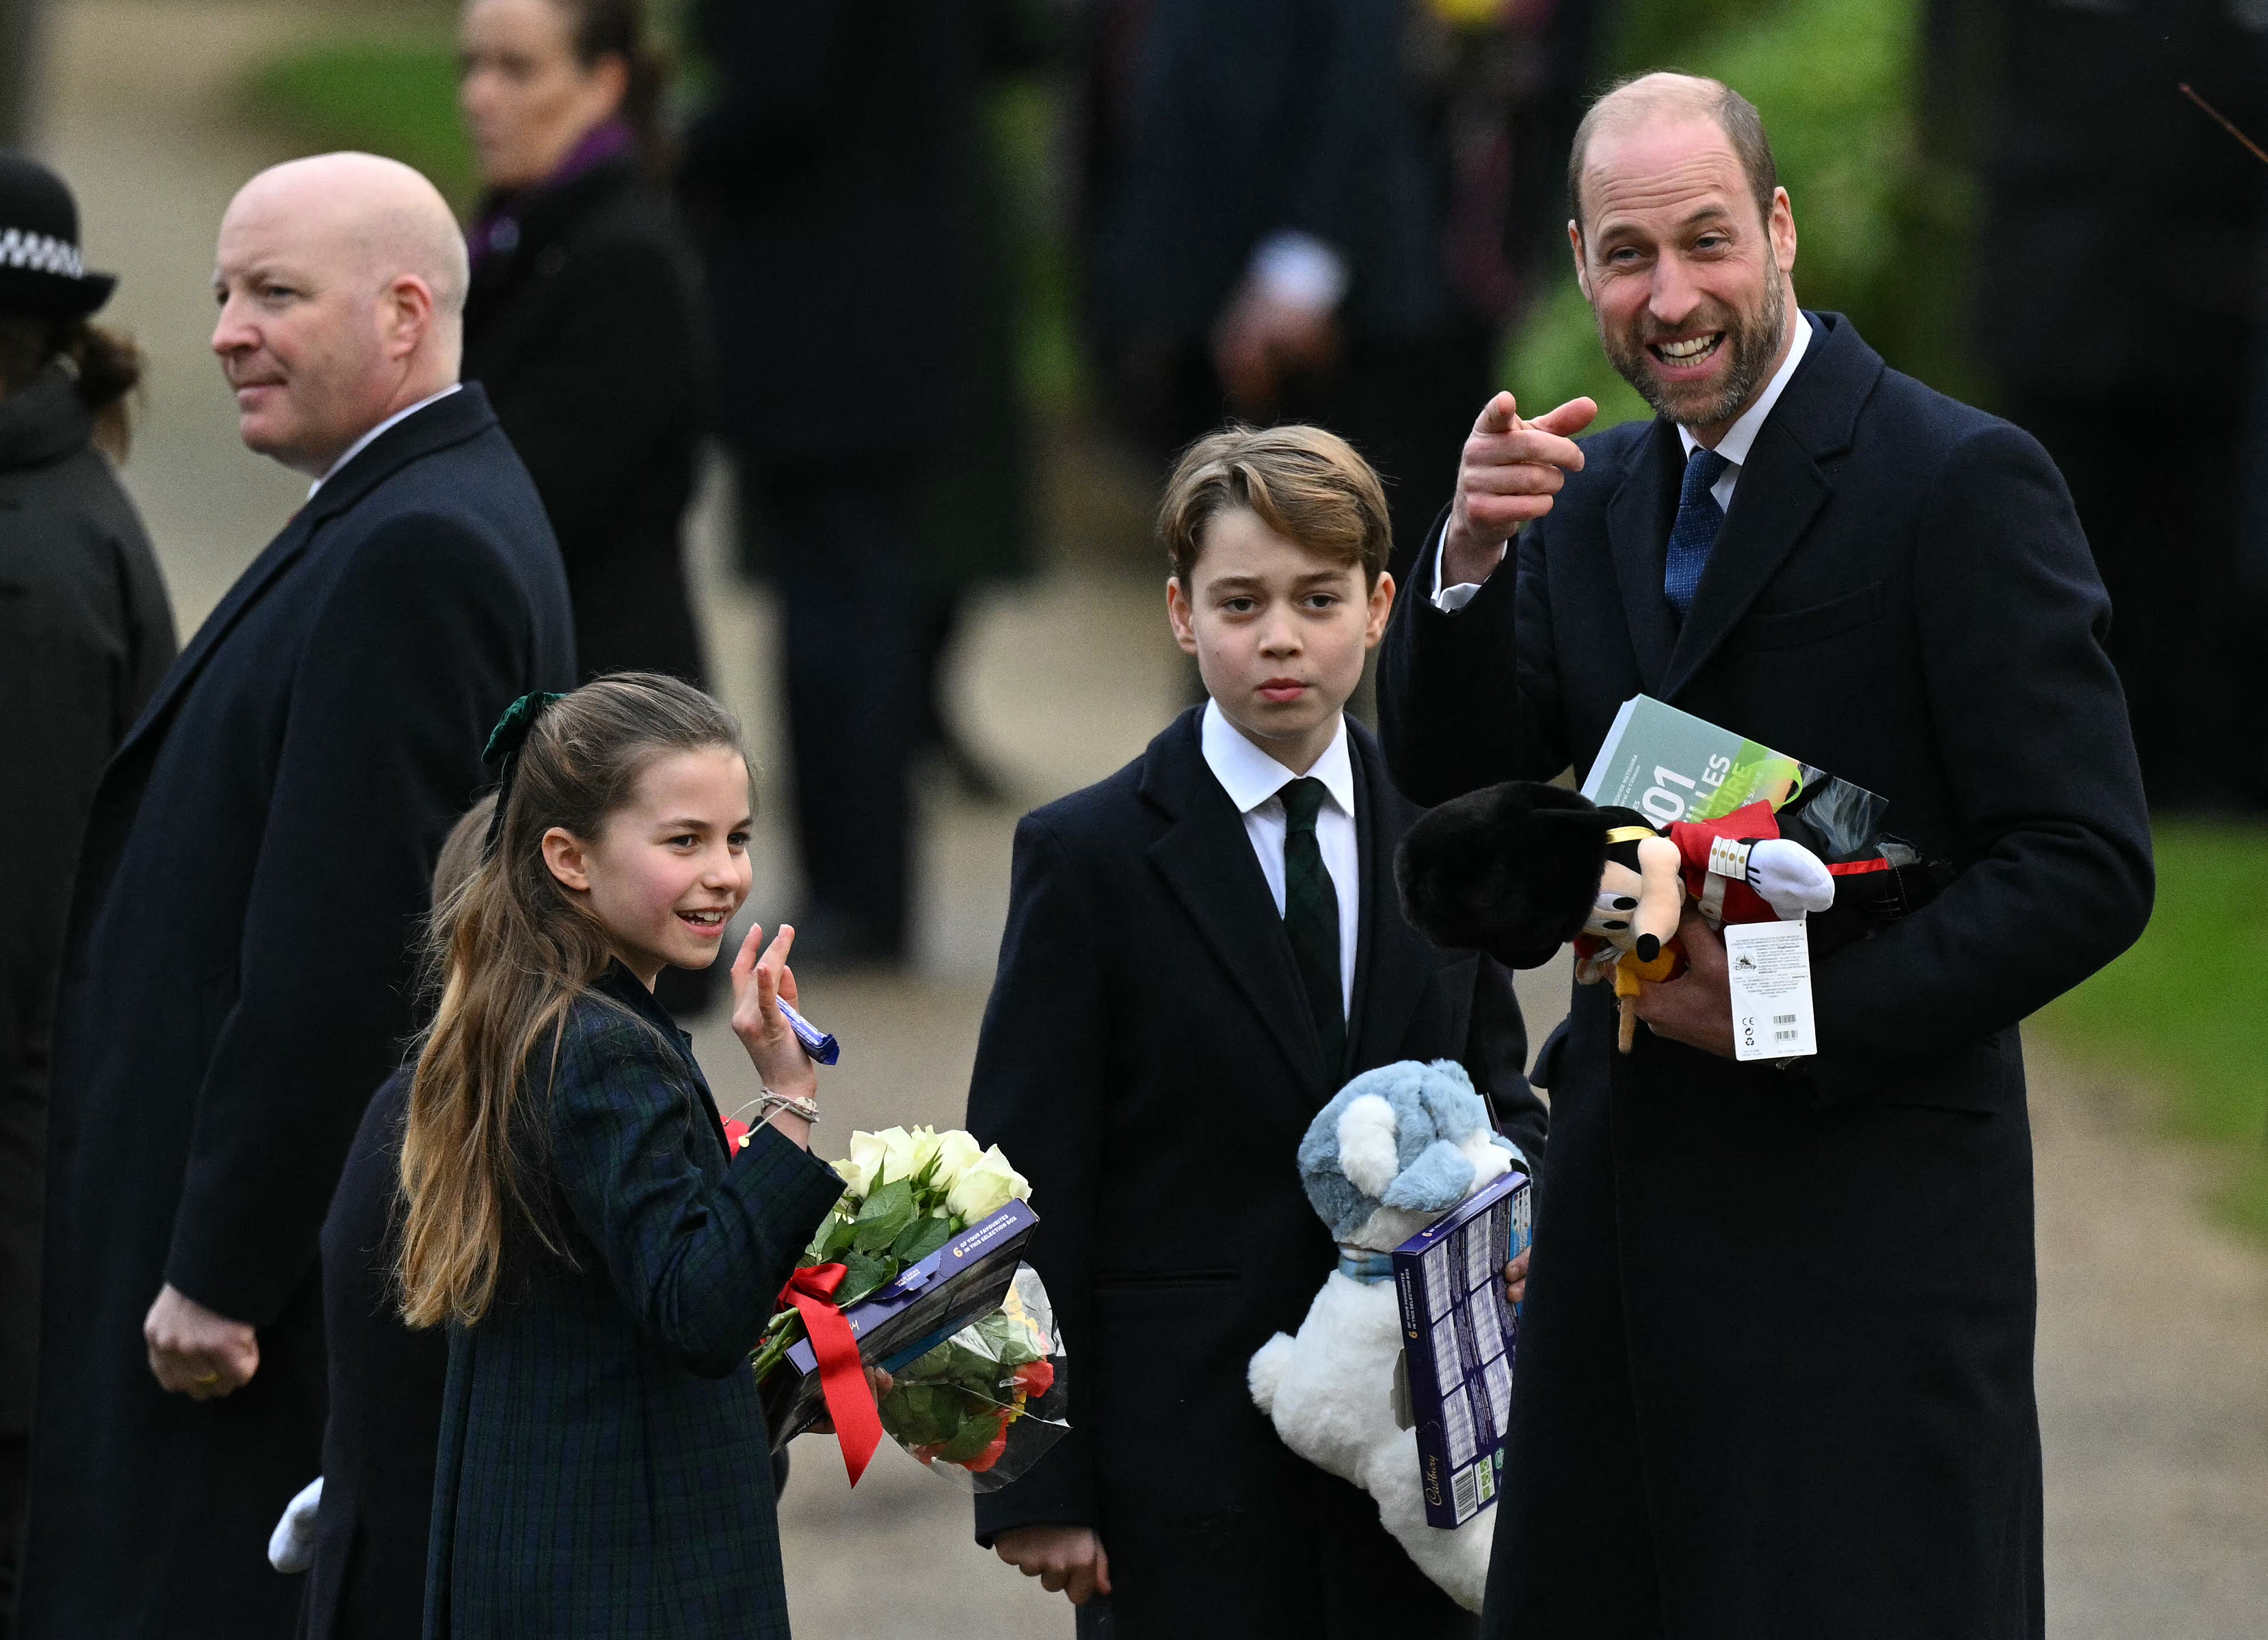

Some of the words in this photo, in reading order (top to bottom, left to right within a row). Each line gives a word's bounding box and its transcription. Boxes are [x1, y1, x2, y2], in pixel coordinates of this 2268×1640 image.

[1742, 1017, 1754, 1026] CE
[953, 1247, 963, 1257] 6
[967, 1232, 981, 1243] YOUR
[980, 1214, 1009, 1235] FAVOURITES
[969, 1240, 982, 1249] THIS
[981, 1222, 1007, 1242] SELECTION
[1006, 1216, 1017, 1225] BOX
[1426, 1455, 1442, 1506] Cadbury
